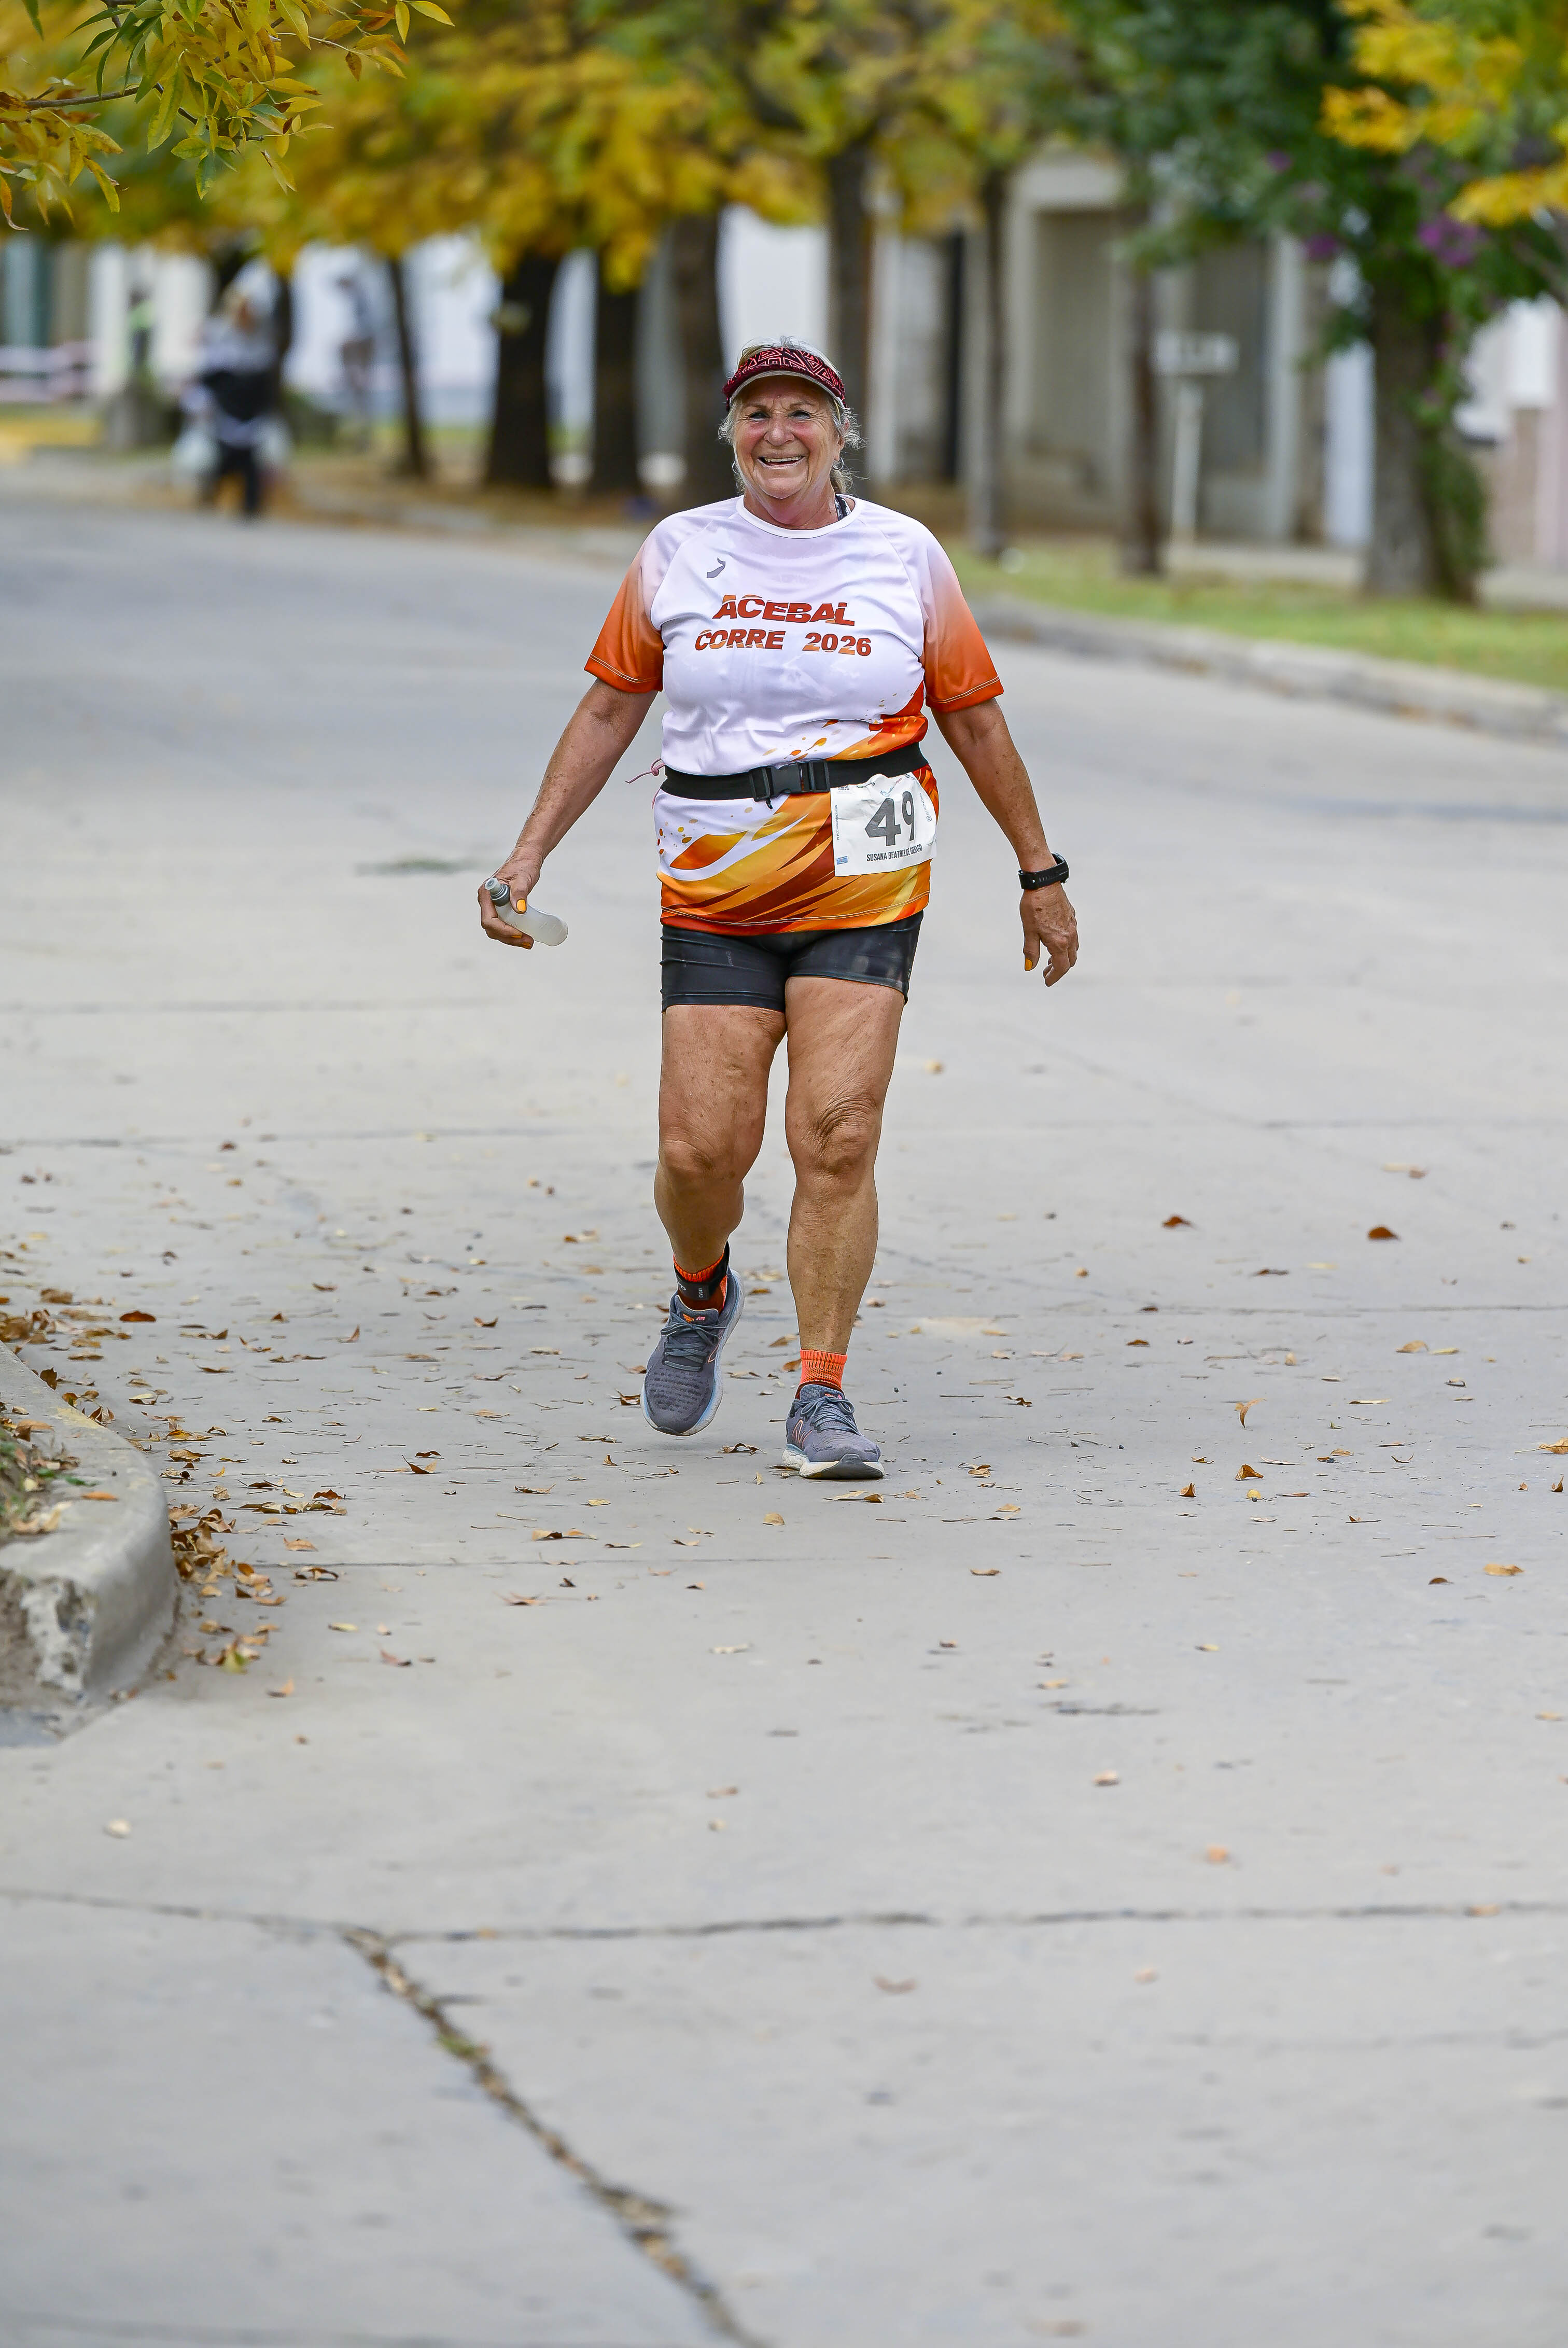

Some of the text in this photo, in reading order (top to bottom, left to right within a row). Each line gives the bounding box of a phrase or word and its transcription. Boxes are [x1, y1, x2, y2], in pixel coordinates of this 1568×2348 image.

[712, 594, 855, 626] ACEBAL
[695, 629, 872, 656] CORRE 2026
[864, 791, 915, 846] 49
[866, 852, 887, 862] SUSANA
[888, 849, 906, 859] BEATRIZ
